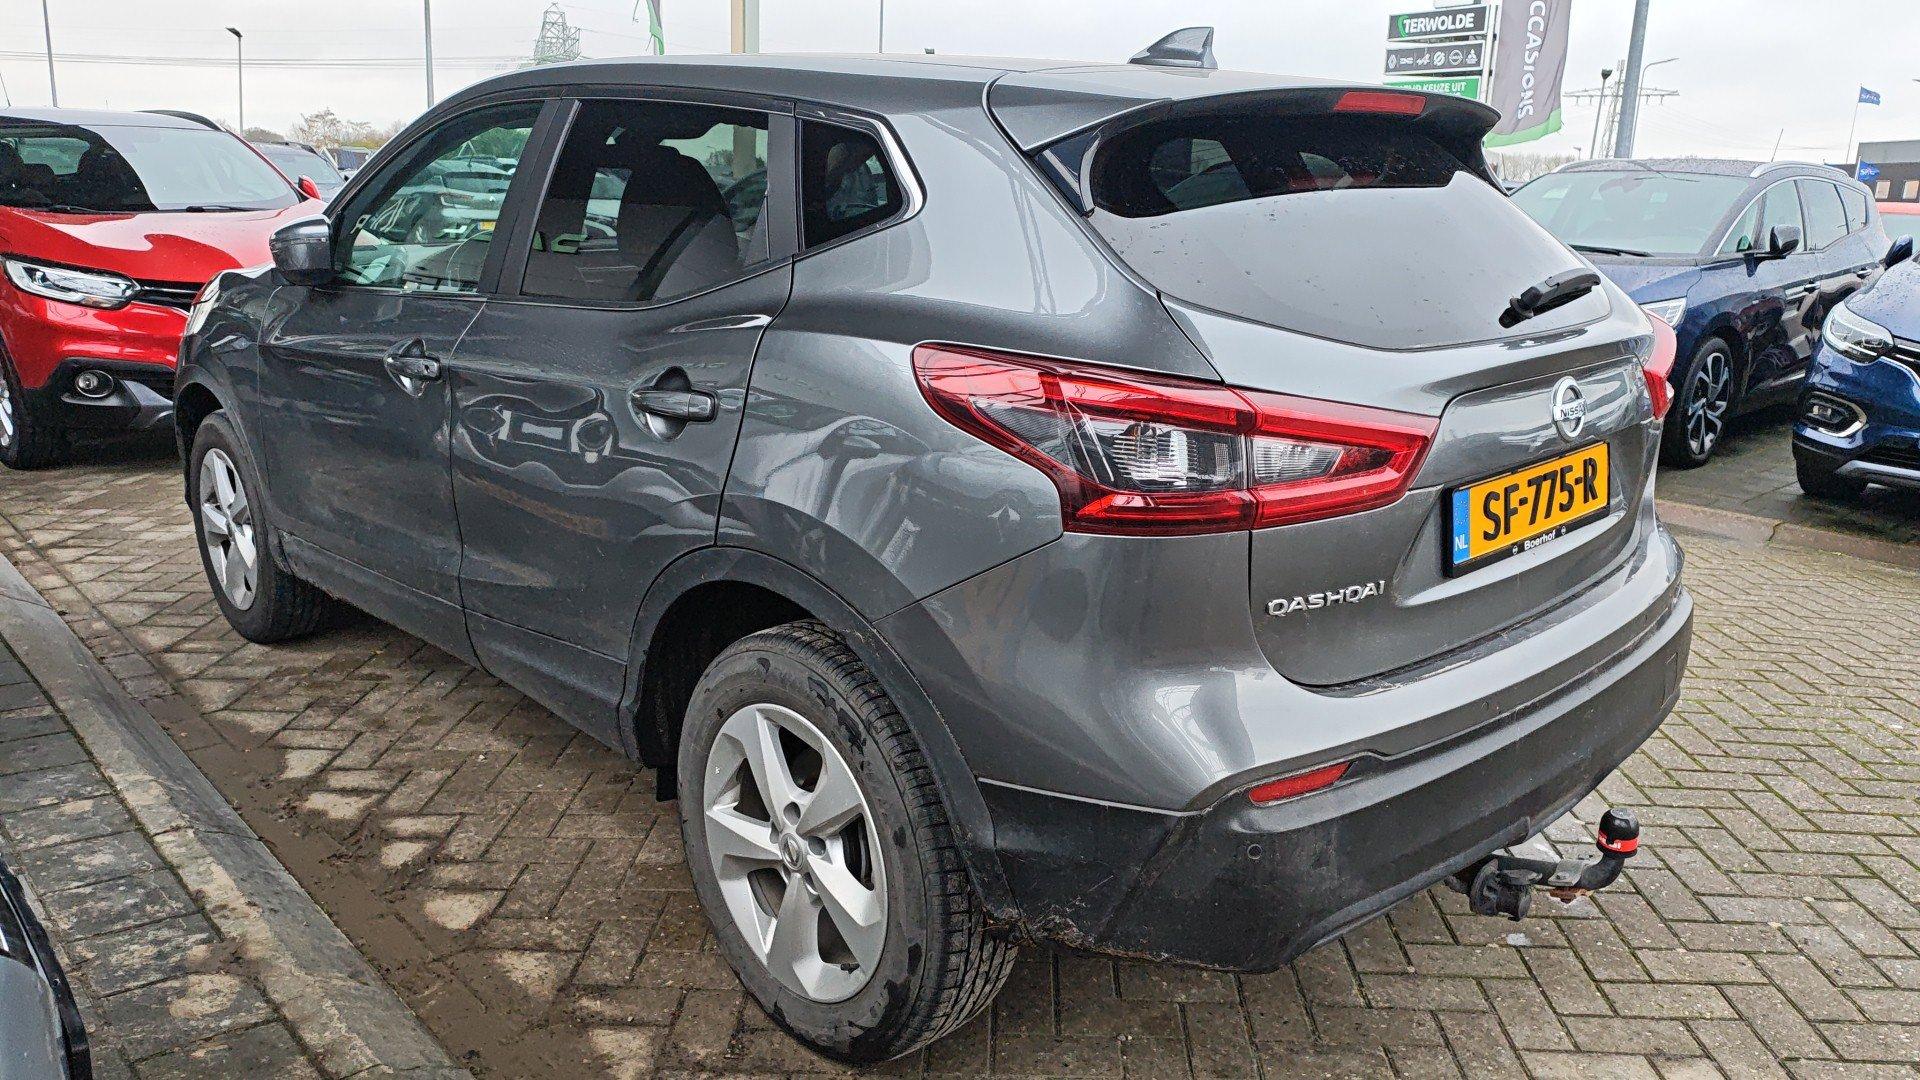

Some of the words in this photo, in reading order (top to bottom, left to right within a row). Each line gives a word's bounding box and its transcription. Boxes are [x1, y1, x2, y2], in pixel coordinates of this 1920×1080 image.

[1403, 12, 1475, 33] TERWOLDE
[1452, 82, 1467, 92] UIT
[1560, 404, 1586, 417] NISSA
[1483, 457, 1598, 541] SF-775-R
[1455, 533, 1468, 551] NL
[1524, 529, 1556, 551] Boerhof
[1268, 580, 1386, 617] QASHQAI
